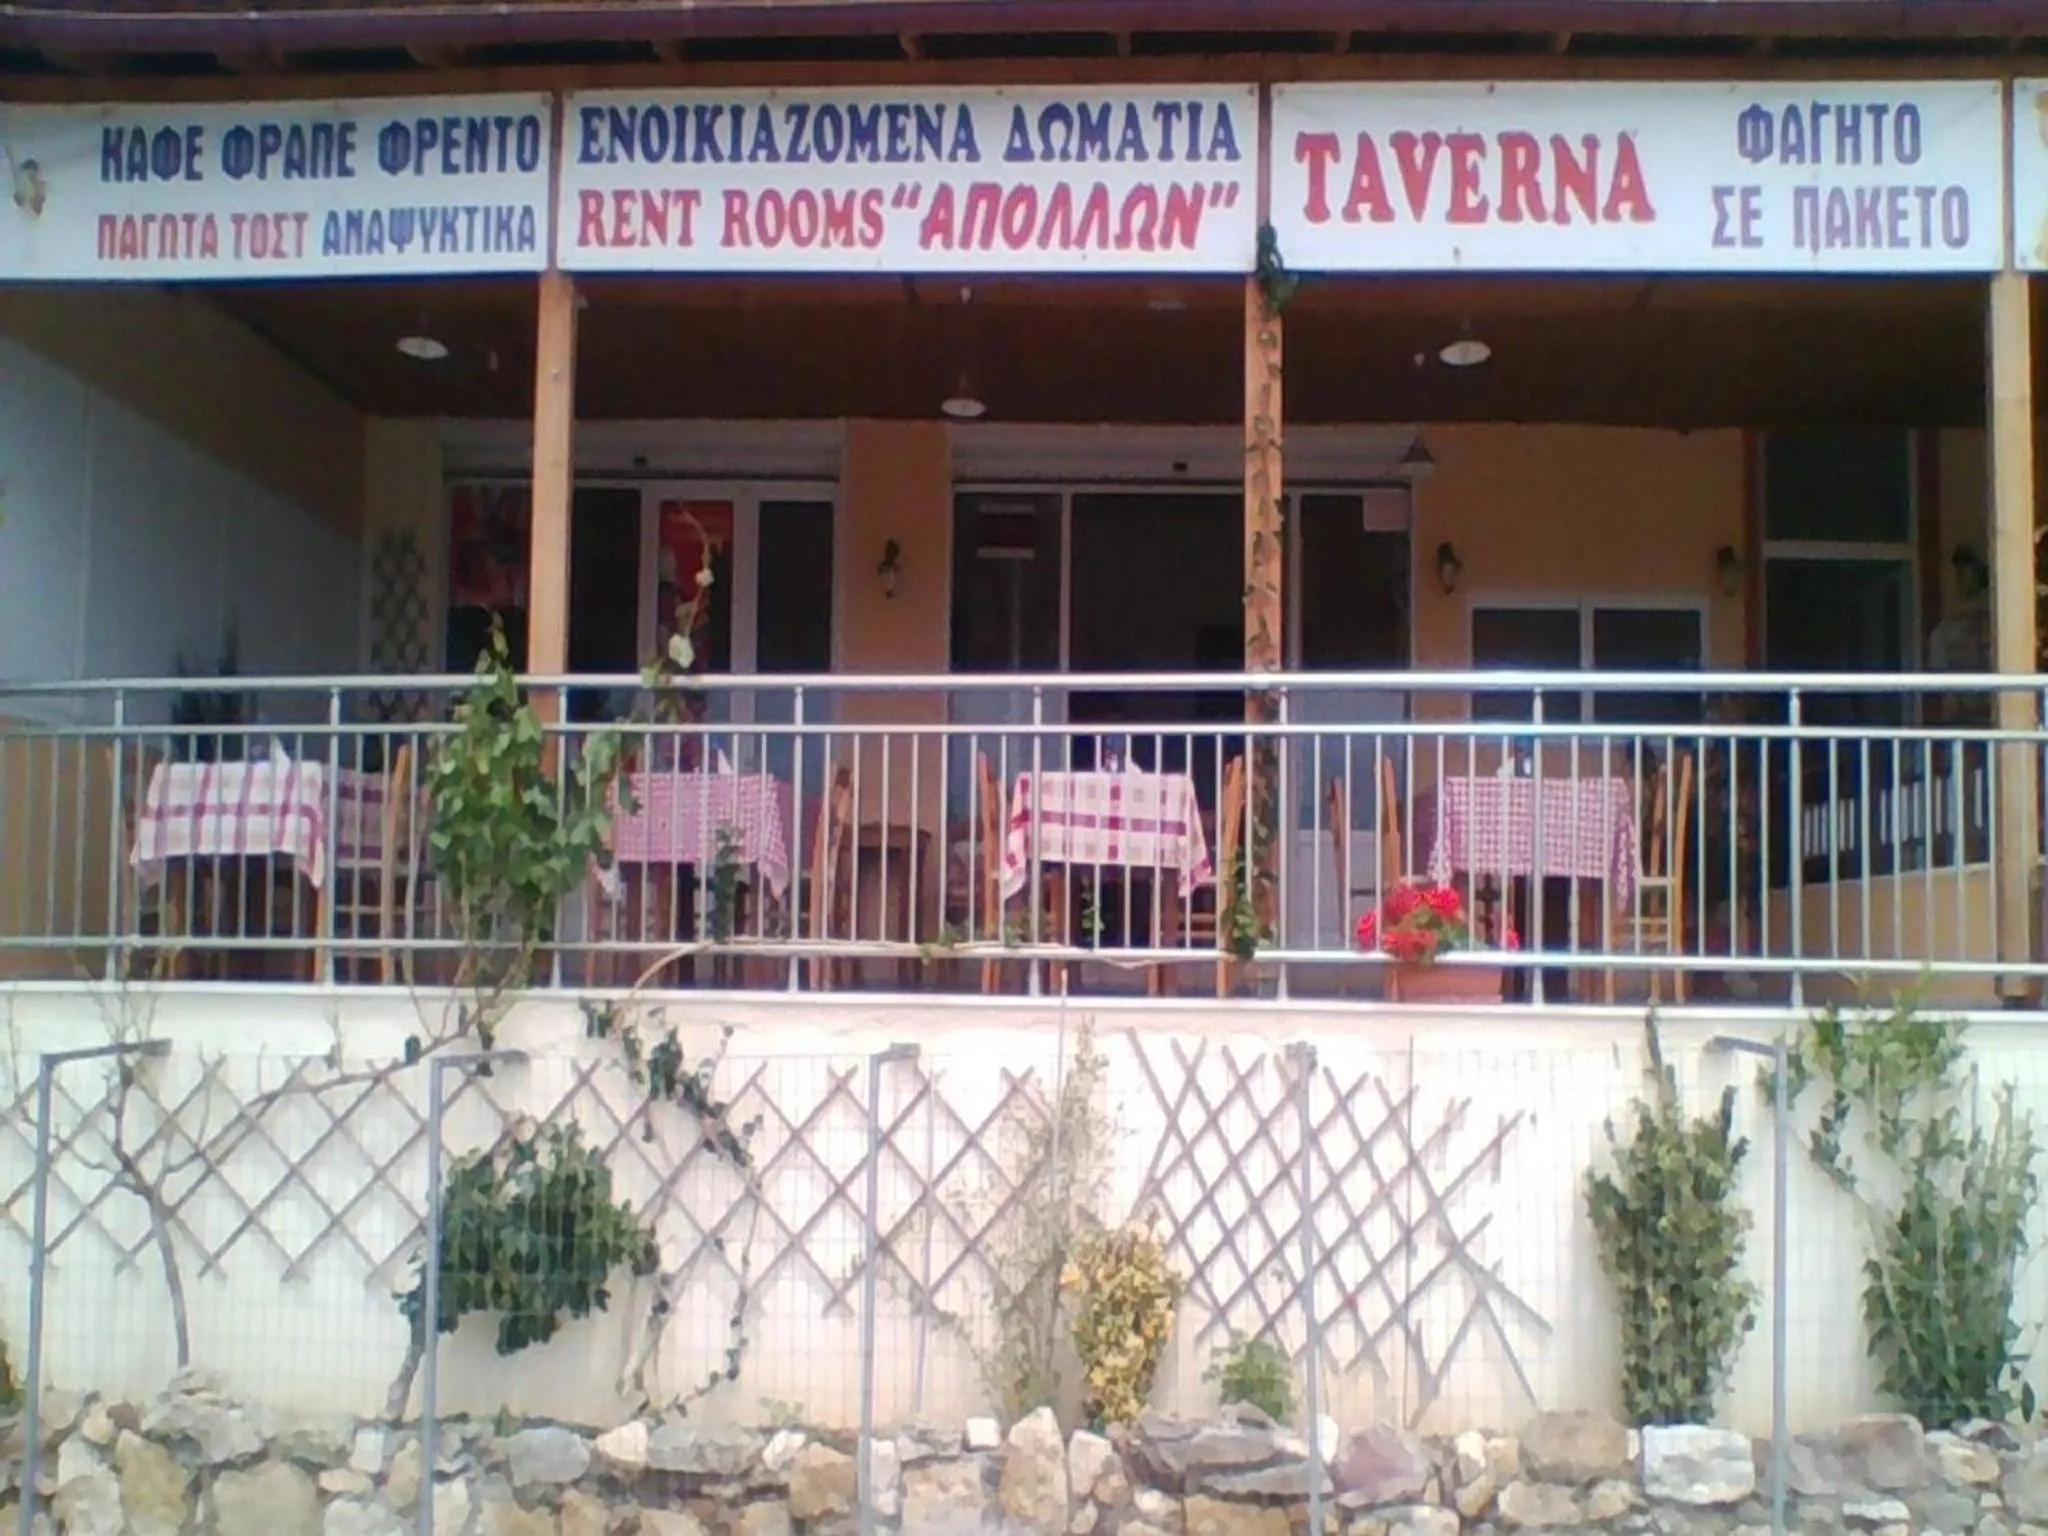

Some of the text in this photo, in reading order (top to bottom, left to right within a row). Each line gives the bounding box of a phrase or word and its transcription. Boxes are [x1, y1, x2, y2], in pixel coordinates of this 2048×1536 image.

[101, 114, 539, 182] ΚΑΦΕ ΦΡΑΠΕ ΦΡΕΝΤΟ
[577, 101, 1241, 164] ΕΝΟΙΚΙΑΖΟΜΕΝΑ ΔΩΜΑΤΙΑ
[1737, 100, 1922, 165] ΦΑΓΗΤΟ
[1295, 130, 1656, 226] TAVERNA
[231, 211, 309, 260] ΤΟΣΤ
[321, 204, 536, 257] ΑΝΑΨΥΚΤΙΚΑ
[577, 188, 699, 248] RENT
[720, 188, 885, 248] ROOMS
[1711, 184, 1971, 253] ΣΕ ΠΑΚΕΤΟ
